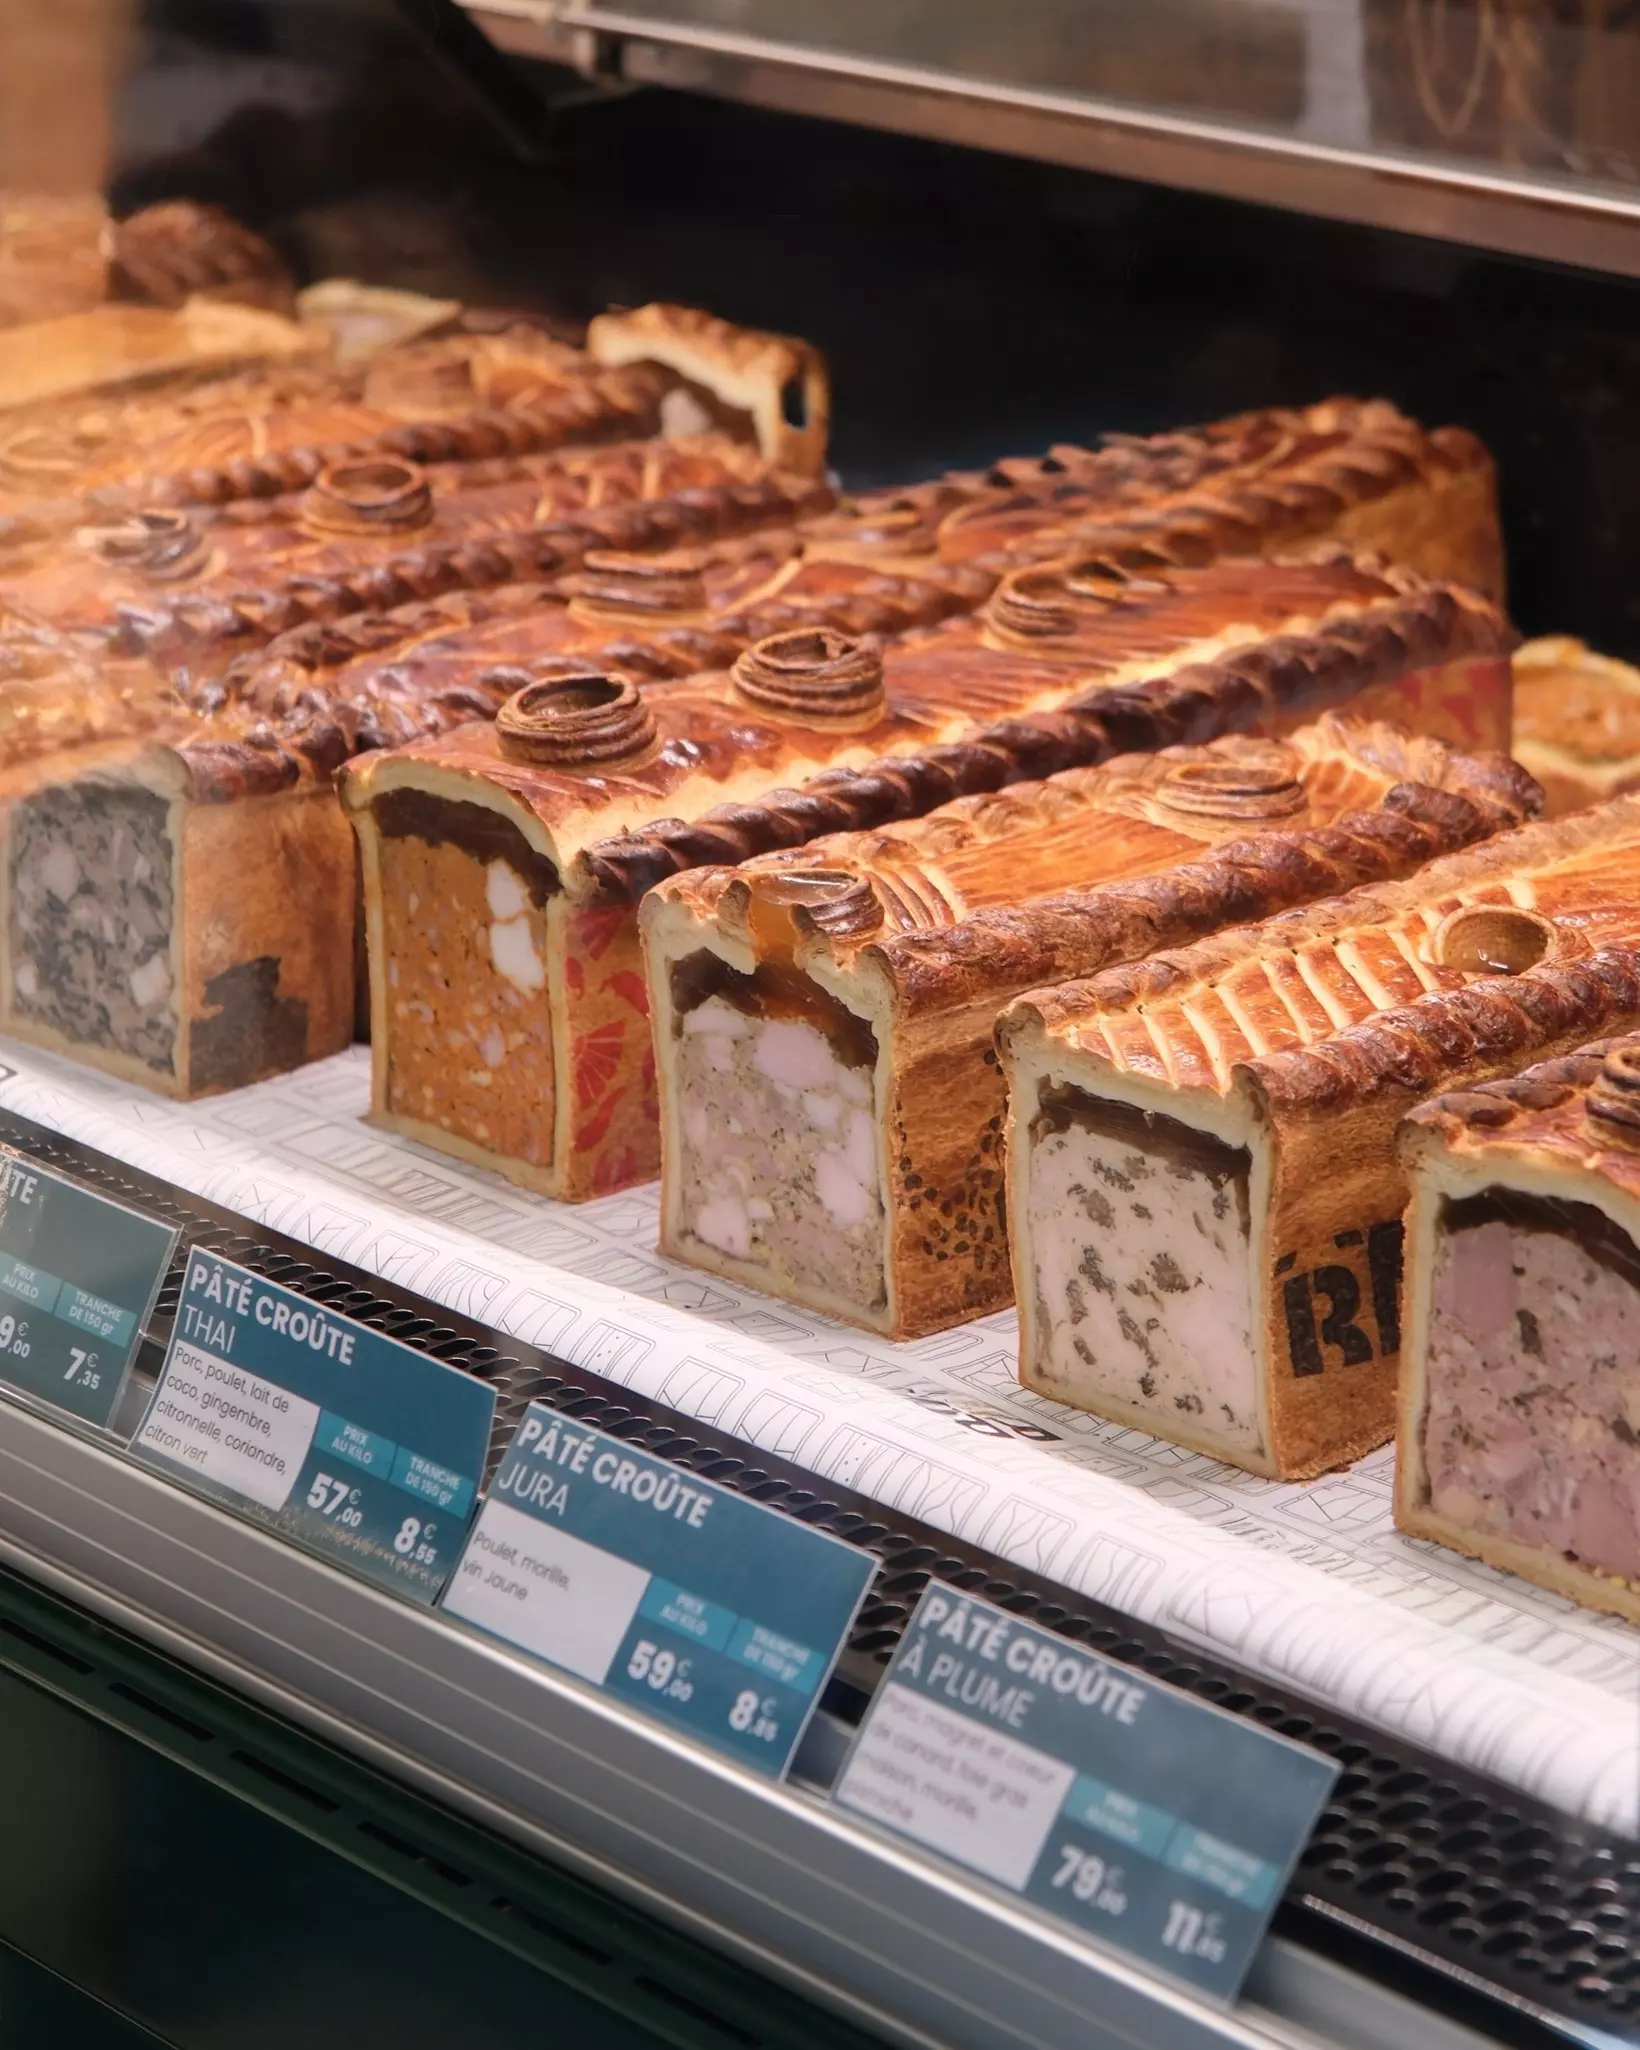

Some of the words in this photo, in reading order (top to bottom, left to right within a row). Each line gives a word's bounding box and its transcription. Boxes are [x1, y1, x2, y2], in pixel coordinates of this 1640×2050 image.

[2, 1273, 19, 1288] AU
[17, 1278, 40, 1299] KILO
[13, 1263, 37, 1281] PRIX
[68, 1304, 84, 1320] DE
[82, 1308, 102, 1329] 150
[99, 1321, 115, 1336] gr
[75, 1290, 124, 1322] TRANCHE
[183, 1303, 237, 1354] THAI
[189, 1263, 254, 1317] PÂTÉ
[254, 1295, 357, 1367] CROÛTE
[165, 1372, 201, 1403] coco,
[200, 1389, 272, 1439] gingembre,
[173, 1346, 204, 1377] Porc,
[206, 1361, 247, 1396] poulet,
[249, 1380, 270, 1406] lait
[271, 1394, 291, 1414] de
[144, 1423, 182, 1453] citron
[181, 1441, 209, 1466] vert
[156, 1398, 222, 1441] citronnelle,
[224, 1433, 288, 1477] coriandre,
[498, 1461, 572, 1517] JURA
[516, 1417, 598, 1476] PÂTÉ
[591, 1451, 716, 1530] CROÛTE
[462, 1559, 483, 1583] vin
[473, 1531, 520, 1569] Poulet,
[519, 1554, 572, 1593] morille,
[896, 1634, 928, 1679] À
[926, 1651, 1036, 1729] PLUME
[918, 1595, 1010, 1662] PÂTÉ
[1004, 1637, 1150, 1726] CROÛTE
